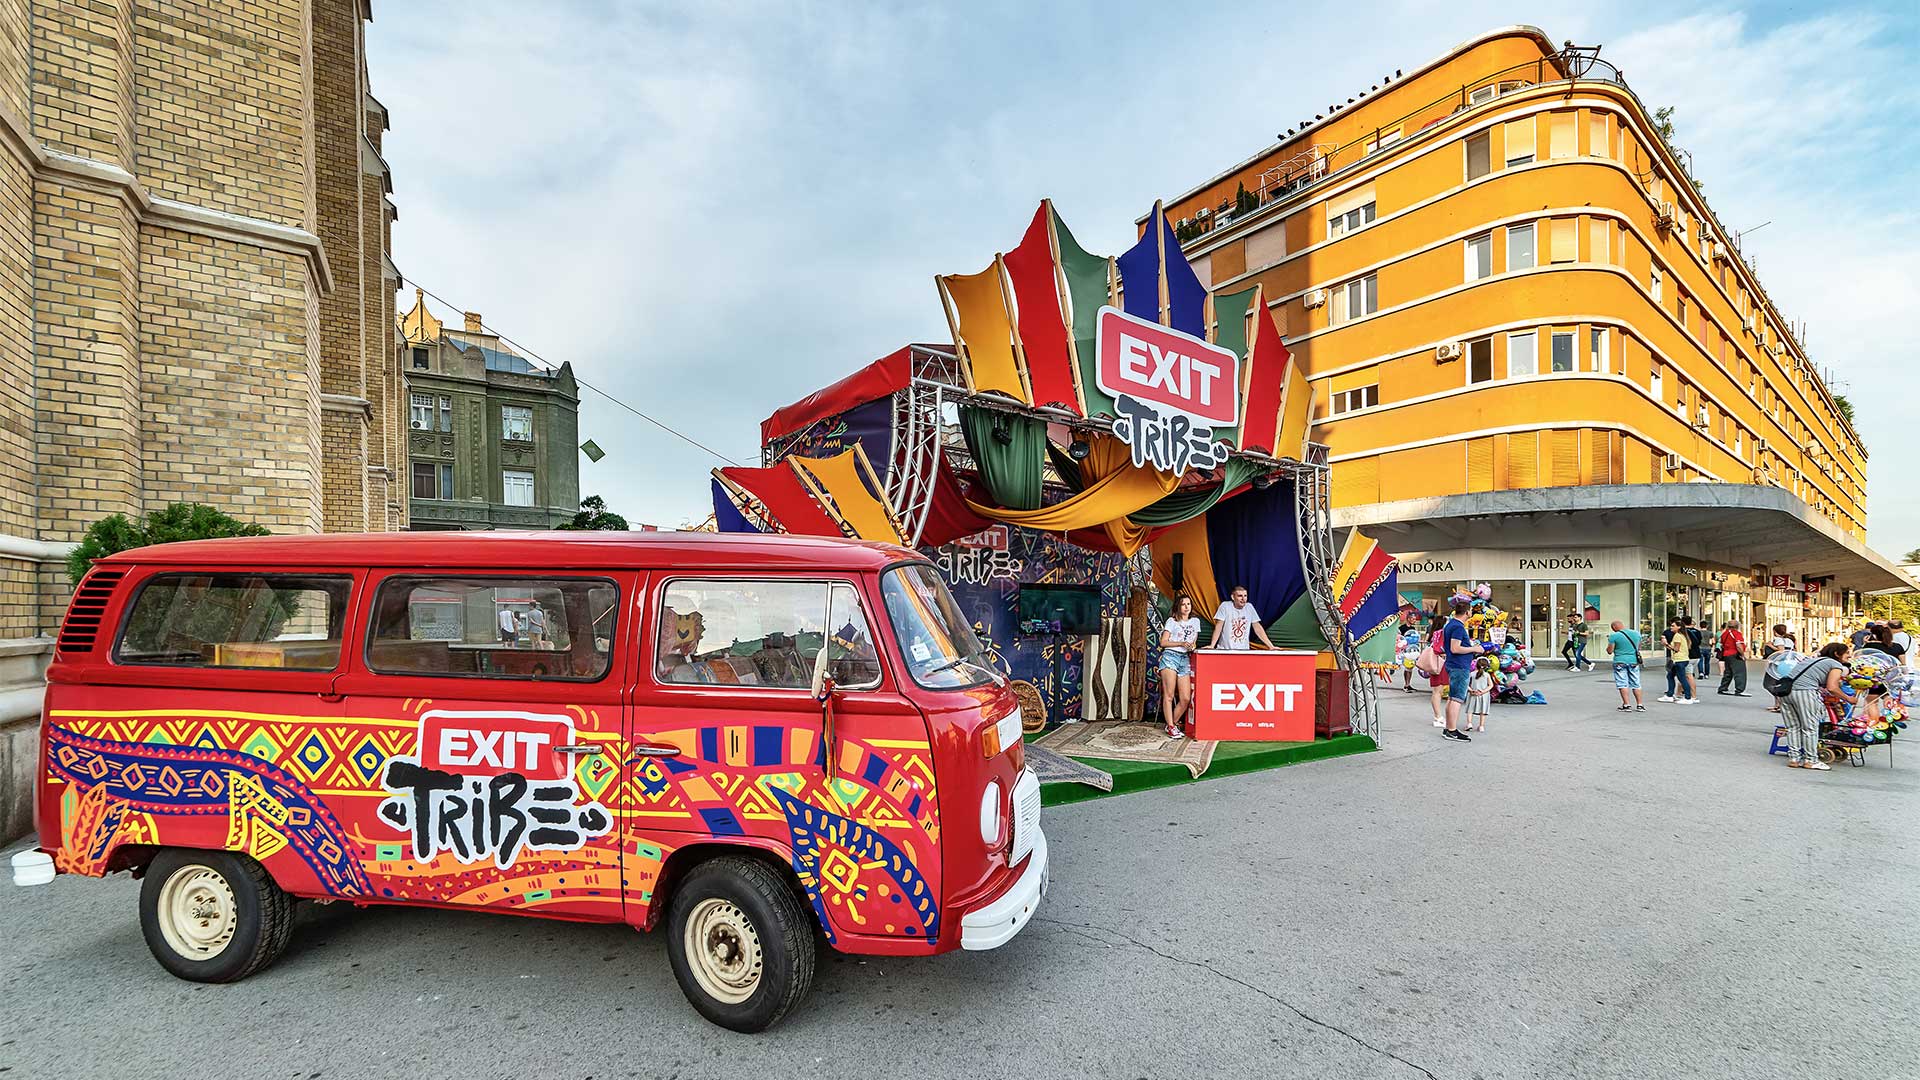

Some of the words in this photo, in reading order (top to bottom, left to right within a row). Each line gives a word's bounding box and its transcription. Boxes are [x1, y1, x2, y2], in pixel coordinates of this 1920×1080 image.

[1119, 332, 1221, 406] EXIT
[1519, 555, 1593, 570] PANDORA
[1211, 683, 1303, 712] EXIT
[439, 728, 550, 770] EXIT
